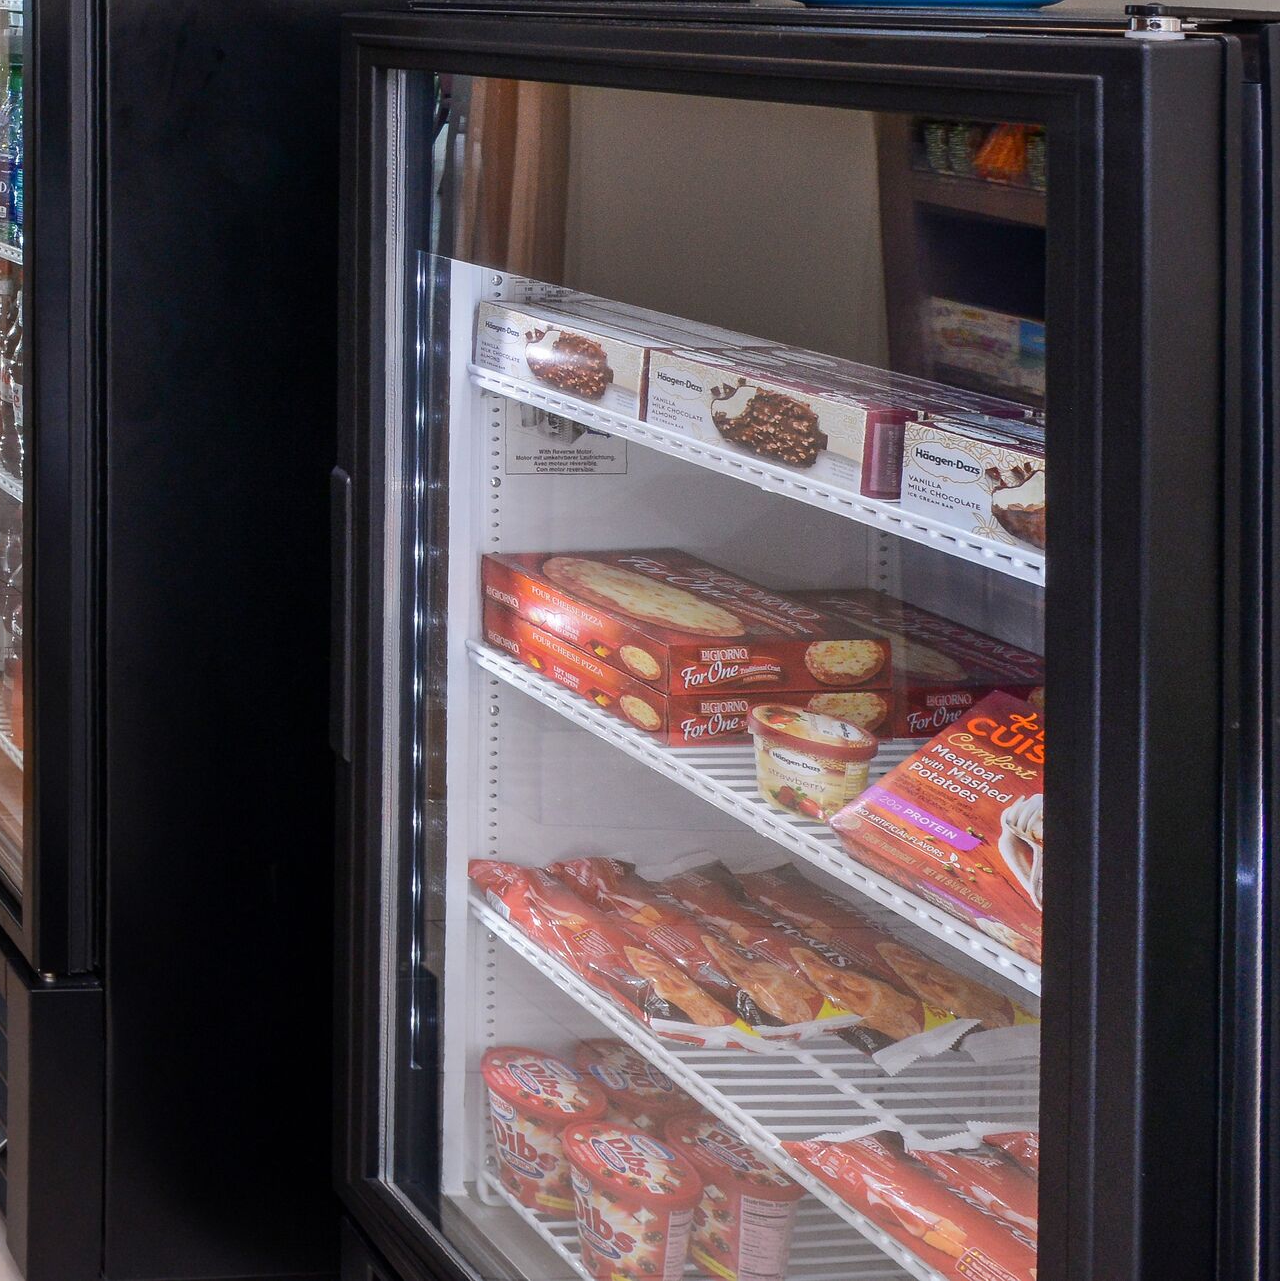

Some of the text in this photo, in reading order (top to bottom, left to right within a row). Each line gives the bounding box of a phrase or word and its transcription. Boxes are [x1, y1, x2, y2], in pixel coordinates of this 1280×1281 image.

[485, 320, 520, 338] Häagen-Dazs
[656, 371, 704, 394] Häagen-Dazs
[651, 409, 678, 421] ALMOND
[652, 395, 676, 407] VANILLA
[652, 401, 704, 423] MILK CHOCOLATE
[515, 454, 532, 462] Motor
[915, 447, 981, 477] Häagen-Dazs
[908, 474, 942, 490] VANILLA
[908, 483, 982, 511] MILK CHOCOLATE
[918, 494, 940, 506] CREAM
[942, 501, 955, 510] BAR
[531, 585, 604, 628] FOUR CHEESE PIZZA
[531, 631, 604, 677] FOUR CHEESE PIZZA
[553, 665, 581, 683] LIFT HERE
[554, 671, 580, 689] TO OPEN
[680, 661, 740, 689] For One
[680, 714, 740, 741] For One
[906, 706, 963, 733] For One
[966, 717, 1045, 764] CUIS
[771, 751, 822, 775] Häagen-Dazs
[931, 744, 1005, 786] Meatloaf
[947, 732, 1040, 781] Comfort
[768, 766, 827, 794] strawberry
[908, 760, 980, 804] Potatoes
[920, 755, 947, 772] with
[948, 765, 1014, 804] Mashed
[878, 794, 902, 811] 20g
[903, 807, 958, 840] PROTEIN
[856, 806, 945, 858] NO ARTIFICIAL FLAVORS
[522, 1062, 564, 1099] Dibs
[492, 1114, 561, 1172] Dibs
[607, 1137, 652, 1179] Dibs
